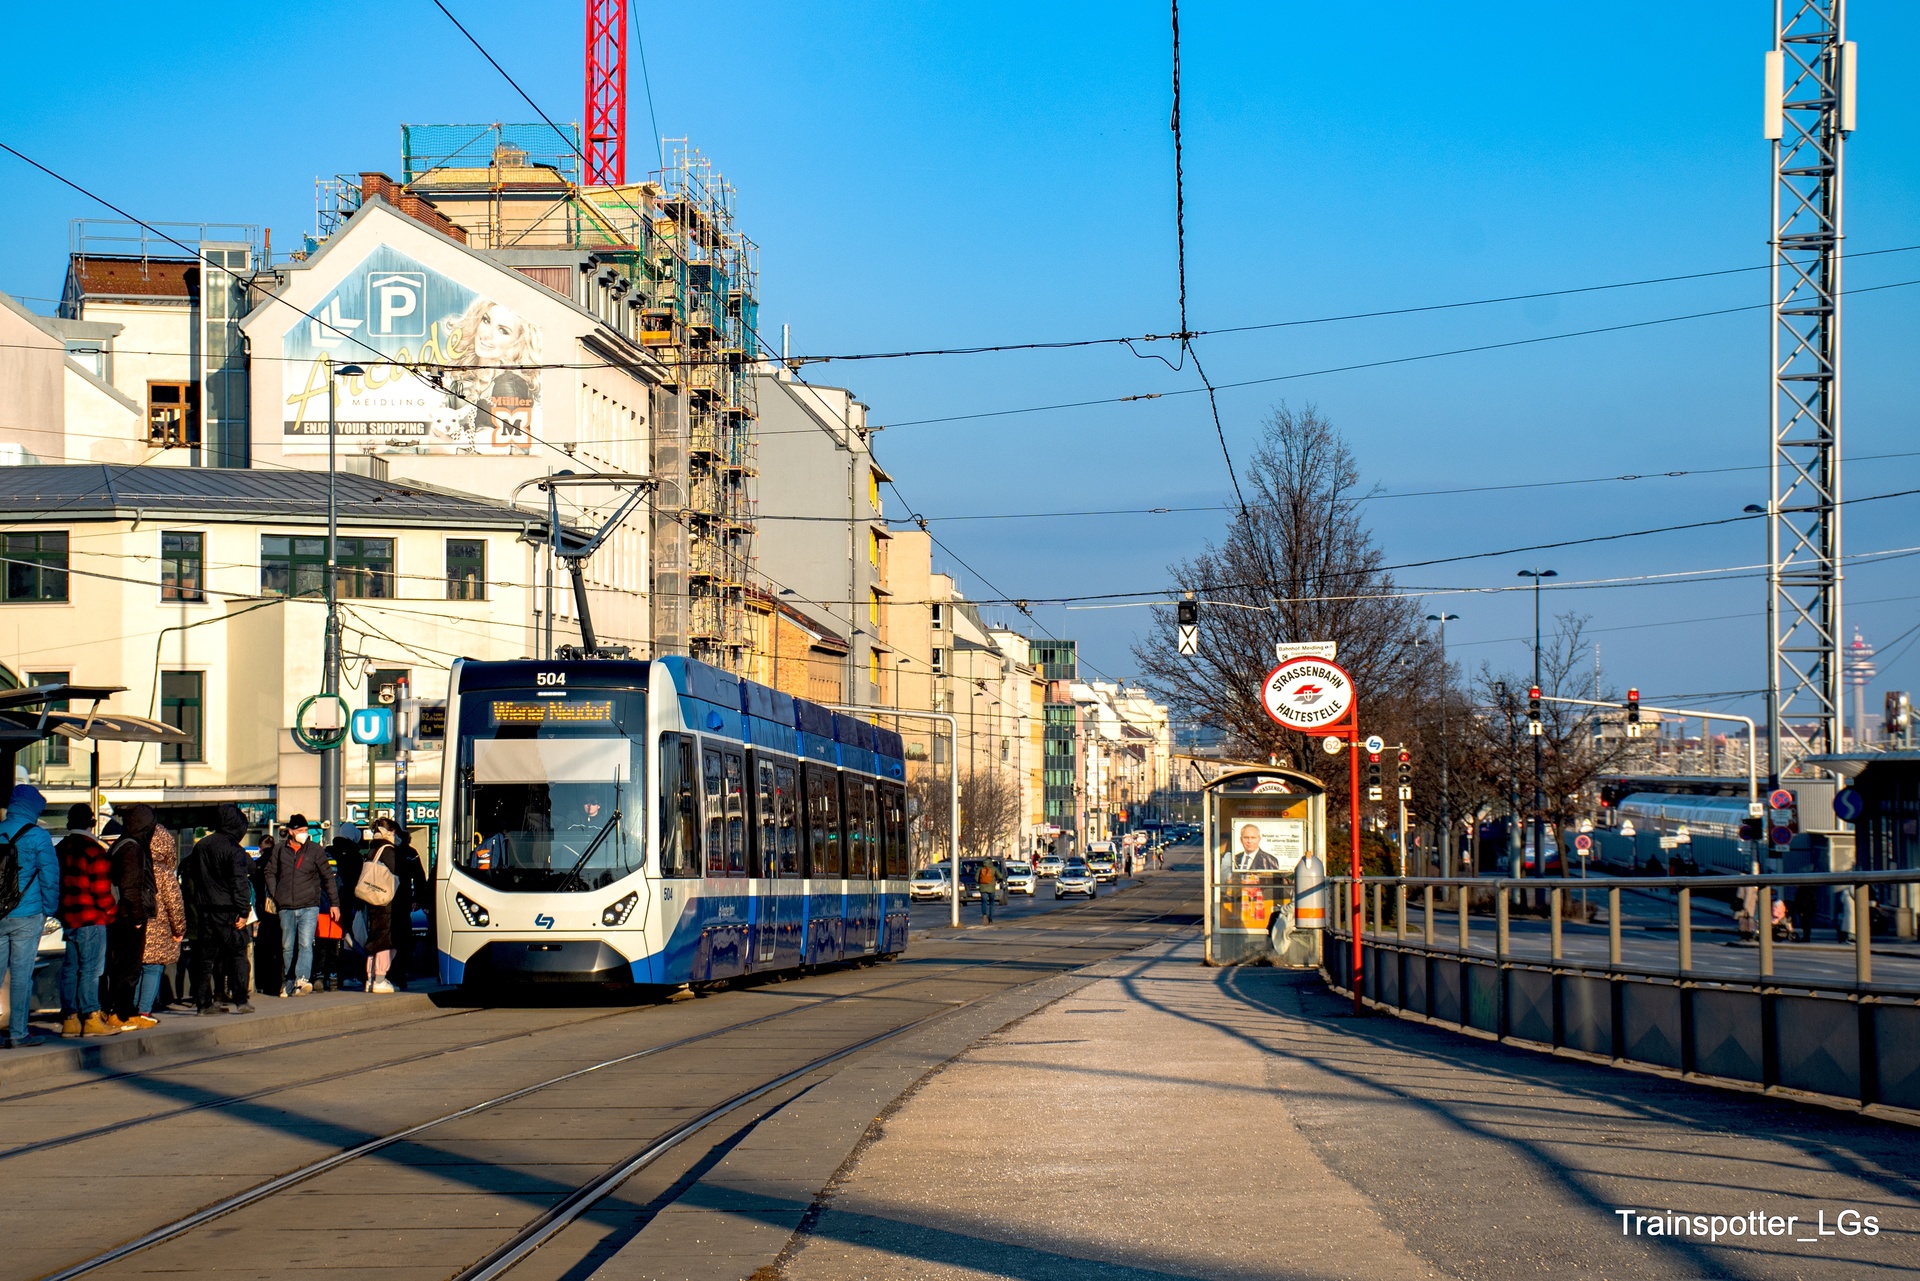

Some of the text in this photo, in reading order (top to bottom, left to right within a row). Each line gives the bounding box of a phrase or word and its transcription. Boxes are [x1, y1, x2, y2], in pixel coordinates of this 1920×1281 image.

[380, 286, 417, 333] P
[286, 320, 470, 431] Arcade
[352, 398, 426, 406] MEIDLING
[492, 396, 532, 407] Müller
[338, 422, 368, 434] YOUR
[369, 422, 425, 434] SHOPPING
[501, 418, 522, 436] M
[536, 672, 566, 686] 504
[1271, 666, 1344, 692] STRASSENBAHN
[493, 701, 612, 720] Wiener Neudorf
[1276, 699, 1343, 722] HALTESTELLE
[356, 715, 380, 740] U
[1325, 740, 1340, 750] 62
[663, 887, 673, 901] 504
